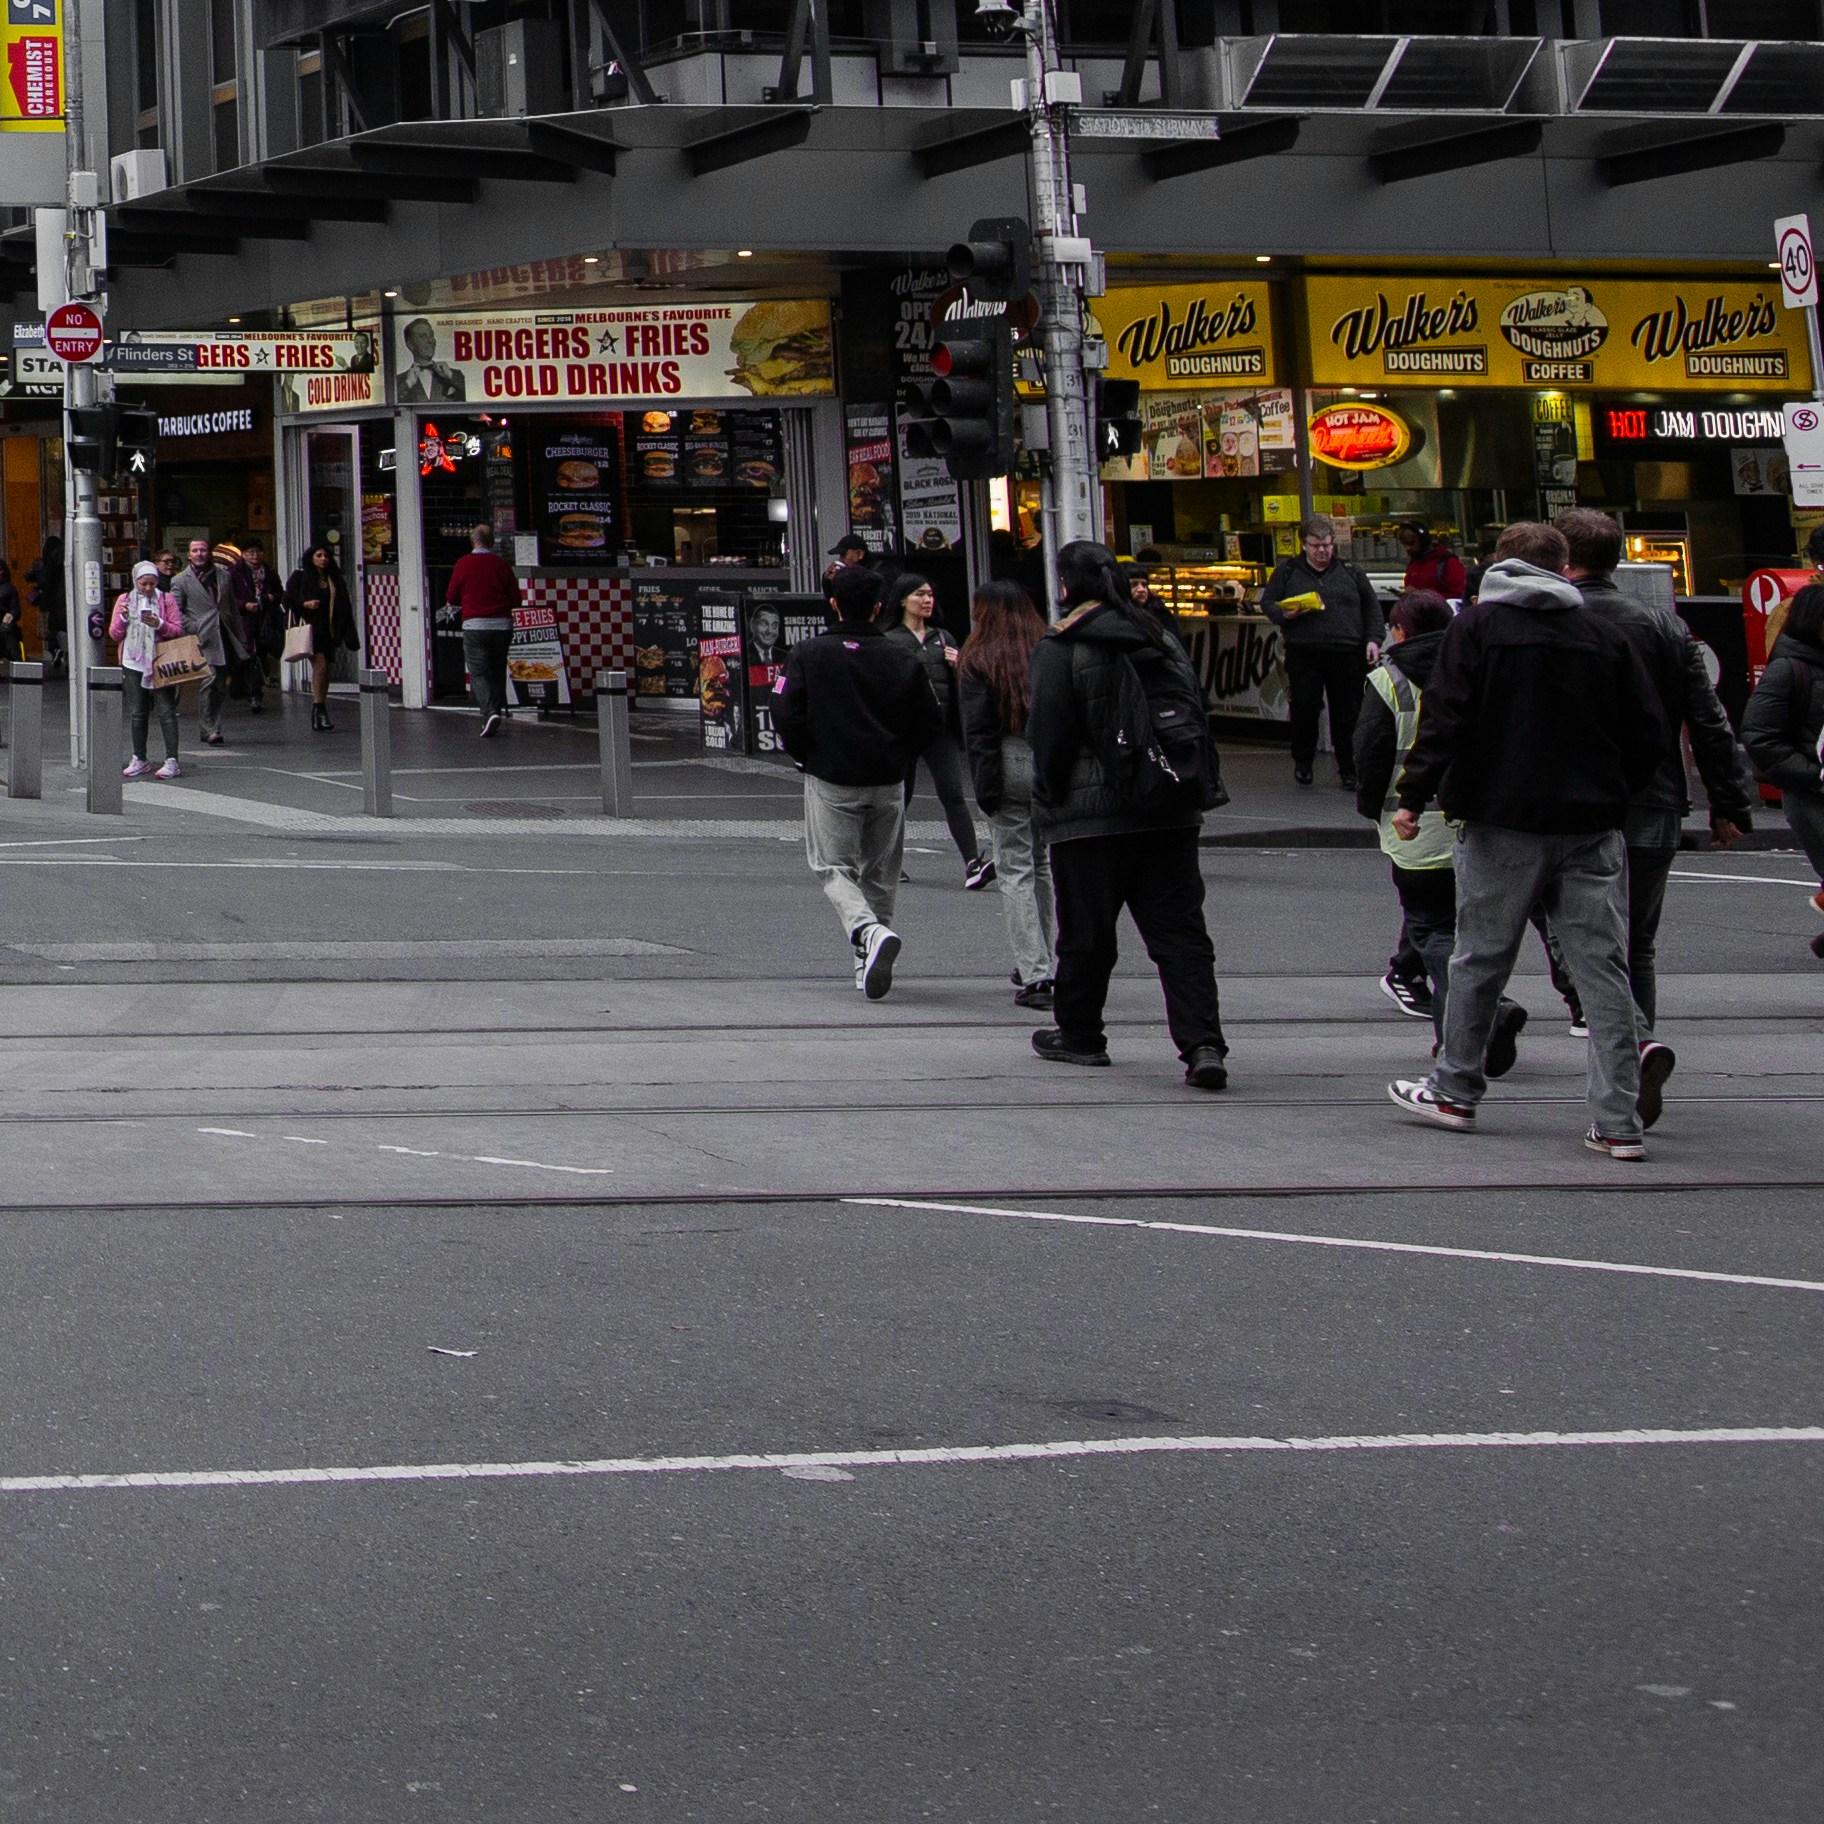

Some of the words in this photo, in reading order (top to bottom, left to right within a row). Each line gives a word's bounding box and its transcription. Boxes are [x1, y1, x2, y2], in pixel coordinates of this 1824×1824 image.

[33, 0, 51, 19] 7
[27, 39, 44, 116] CHEMIST
[45, 42, 55, 115] WAREHOUSE
[1785, 244, 1809, 278] 40
[65, 313, 83, 326] NO
[575, 310, 661, 325] MELBOURNE'S
[663, 307, 732, 321] FAVOURITE
[1508, 297, 1567, 325] Walker's
[13, 324, 46, 339] Elizabeth
[1117, 291, 1256, 368] Walker's
[1331, 290, 1478, 361] Walker's
[1631, 293, 1776, 363] Walker's
[54, 340, 95, 353] ENTRY
[244, 333, 304, 342] MELBOURNE'S
[453, 326, 591, 363] BURGERS
[625, 322, 711, 358] FRIES
[1510, 327, 1601, 359] DOUGHNUTS
[116, 347, 174, 361] Flinders
[177, 348, 194, 361] St
[275, 343, 334, 368] FRIES
[904, 353, 917, 363] We
[1387, 353, 1484, 372] DOUGHNUTS
[1169, 355, 1262, 375] DOUGHNUTS
[1530, 363, 1585, 380] COFFEE
[1688, 357, 1784, 375] DOUGHNUTS
[483, 364, 559, 398] COLD
[566, 360, 682, 396] DRINKS
[307, 377, 332, 405] COLD
[334, 373, 371, 403] DRINKS
[1260, 401, 1291, 418] Coffee
[1536, 399, 1572, 421] COFFEE
[157, 414, 211, 437] TARBUCKS
[212, 409, 253, 431] COFFEE
[1325, 414, 1349, 428] HOT
[1351, 413, 1381, 425] JAM
[1609, 410, 1646, 439] HOT
[1654, 411, 1696, 438] JAM
[545, 447, 609, 459] CHEESEBURGER
[904, 478, 931, 490] BLACK
[548, 501, 578, 513] ROCKET
[579, 502, 611, 513] CLASSIC
[638, 585, 660, 594] FRIES
[523, 607, 554, 627] FRIES
[784, 616, 805, 625] SINCE
[806, 616, 826, 625] 2014
[529, 628, 558, 644] HOUR!
